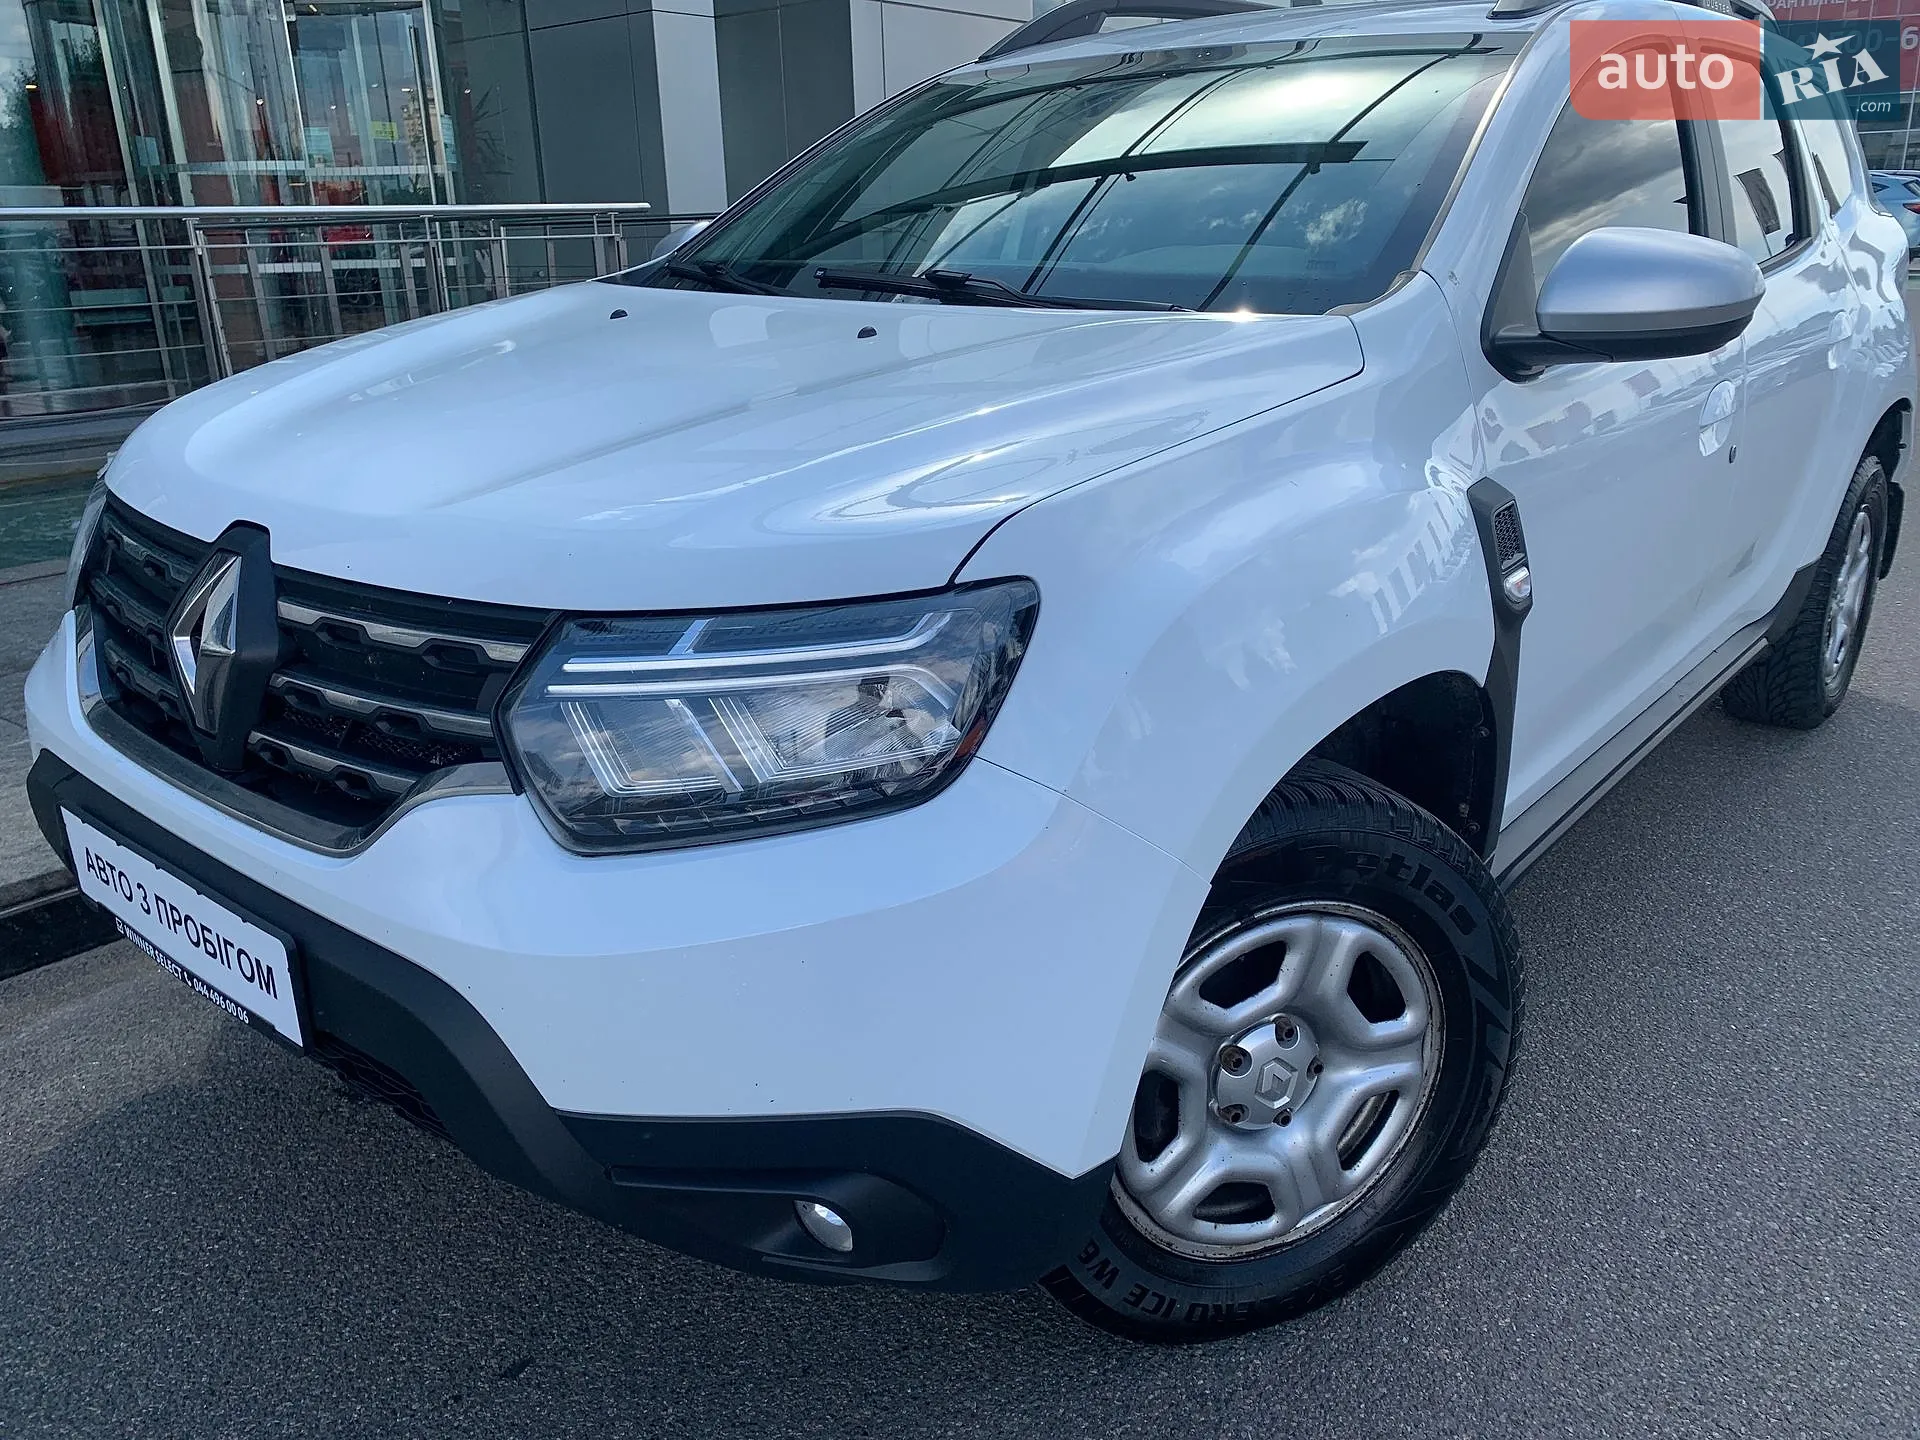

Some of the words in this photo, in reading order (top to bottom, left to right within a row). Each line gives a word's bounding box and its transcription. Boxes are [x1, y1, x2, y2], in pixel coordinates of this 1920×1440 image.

[85, 847, 133, 903] АВТО
[136, 882, 151, 915] З
[153, 893, 278, 1000] ПРОБІГОМ
[124, 925, 156, 960] WINNER
[155, 950, 182, 980] SELECT
[193, 978, 210, 999] 044
[209, 989, 226, 1009] 496
[225, 999, 237, 1017] 00
[237, 1007, 250, 1025] 06
[1121, 1282, 1178, 1319] ICE
